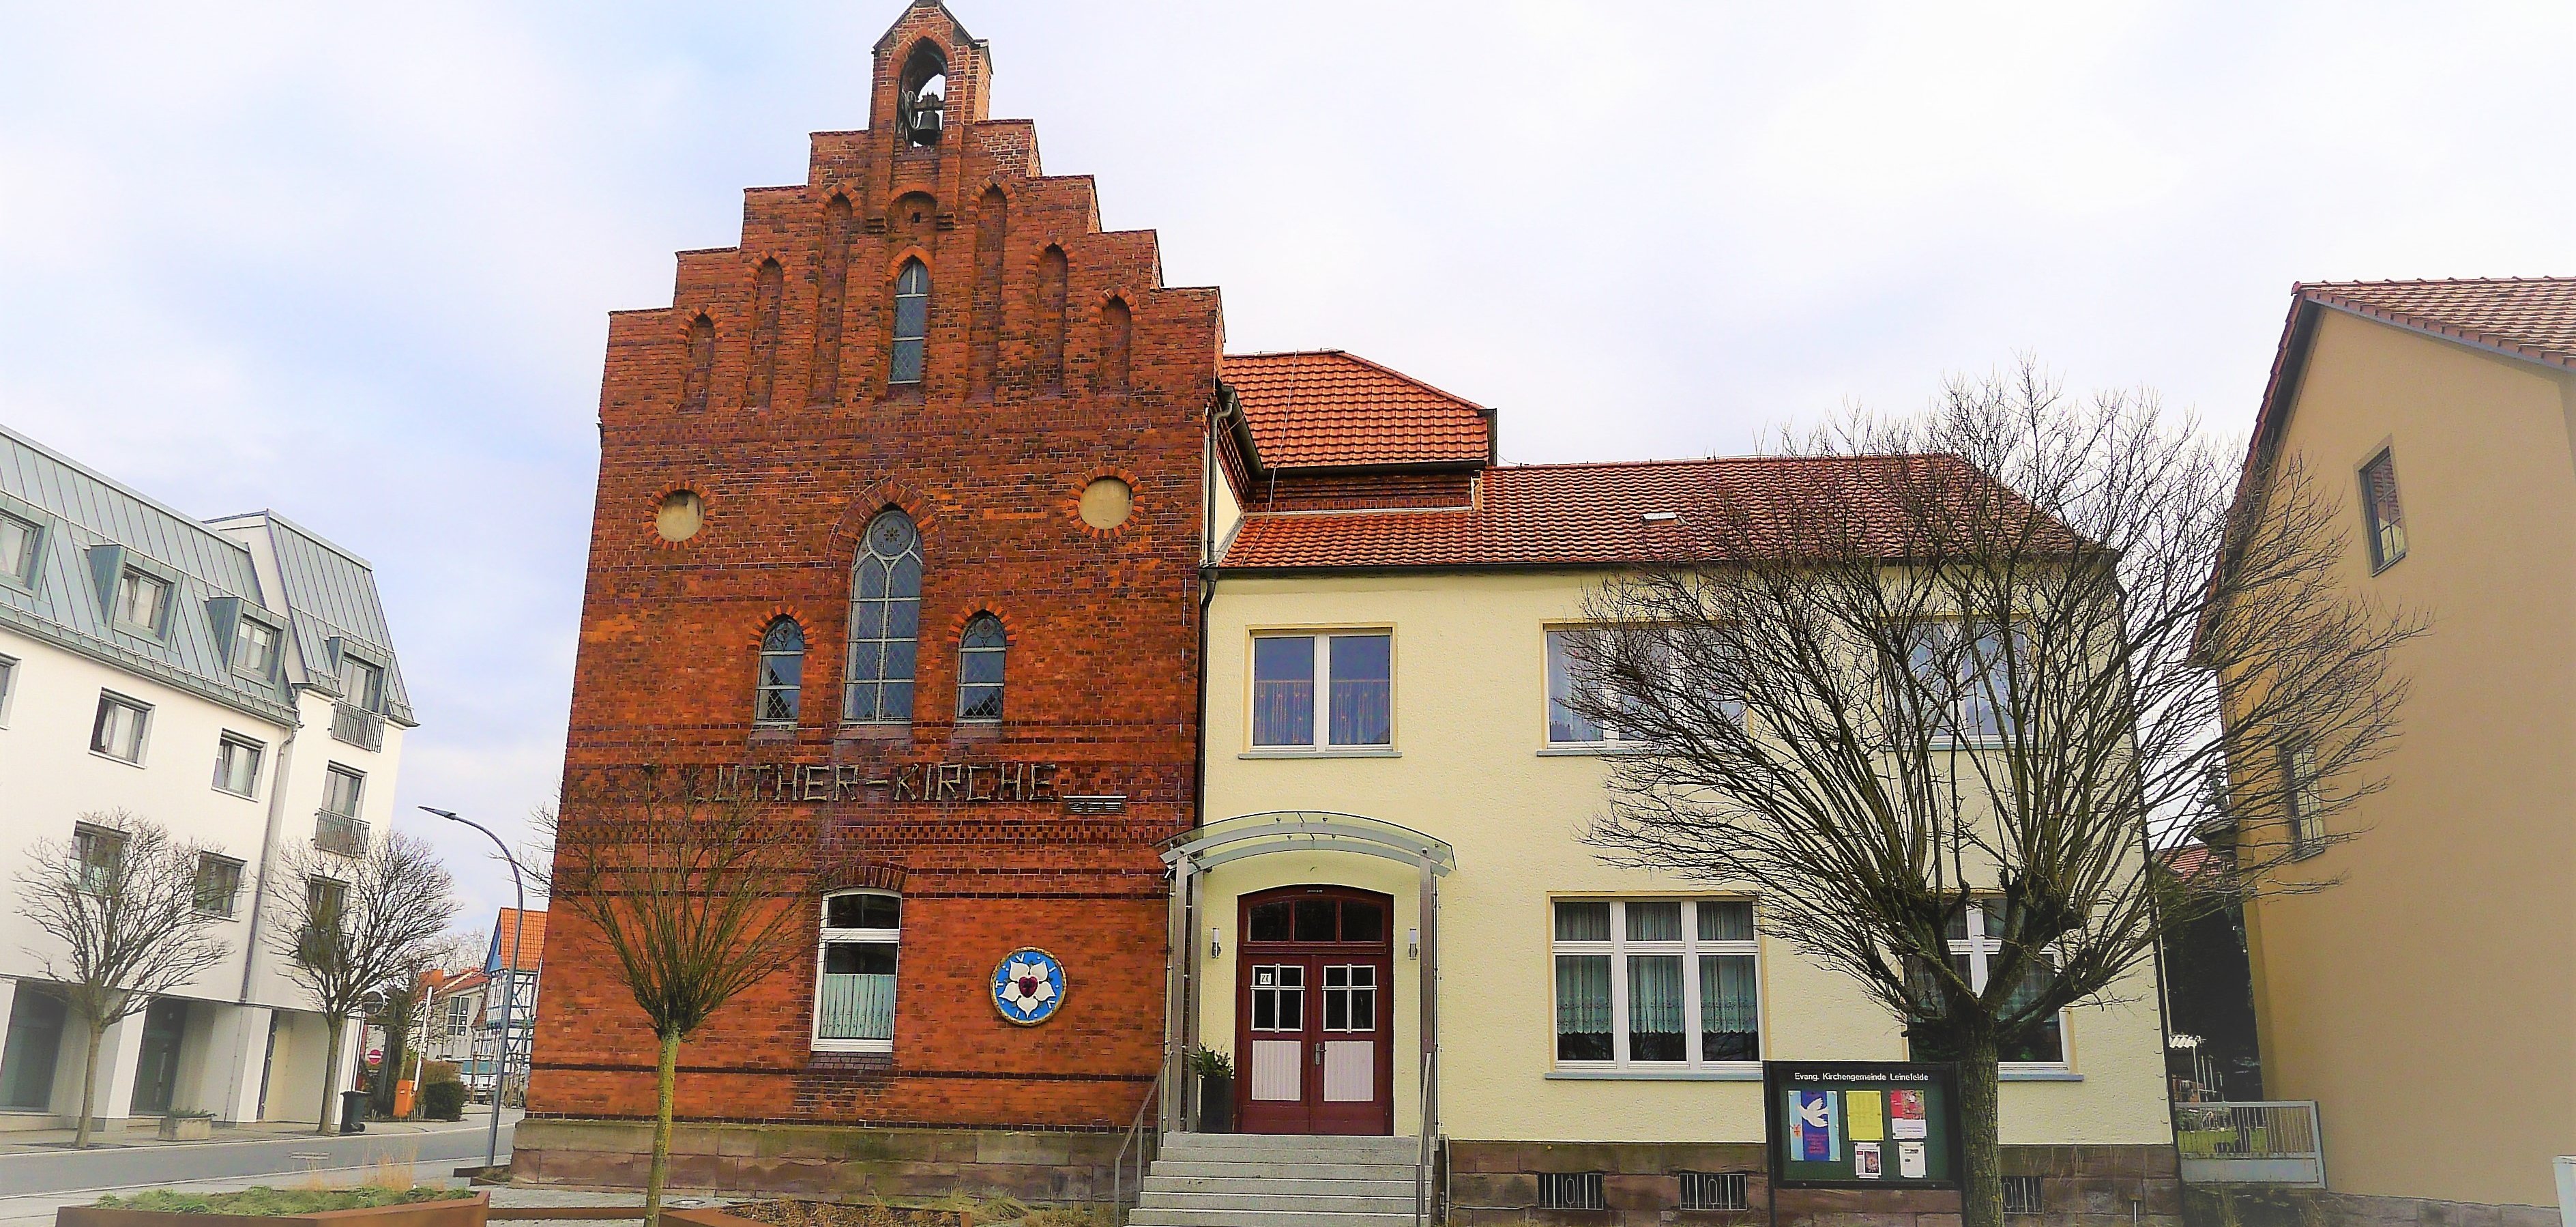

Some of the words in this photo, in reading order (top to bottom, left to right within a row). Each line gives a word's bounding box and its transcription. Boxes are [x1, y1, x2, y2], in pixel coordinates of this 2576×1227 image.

[1794, 1072, 1820, 1082] Evang.
[1822, 1072, 1887, 1082] Kirchengemeinde
[1890, 1072, 1929, 1081] Leinefelde
